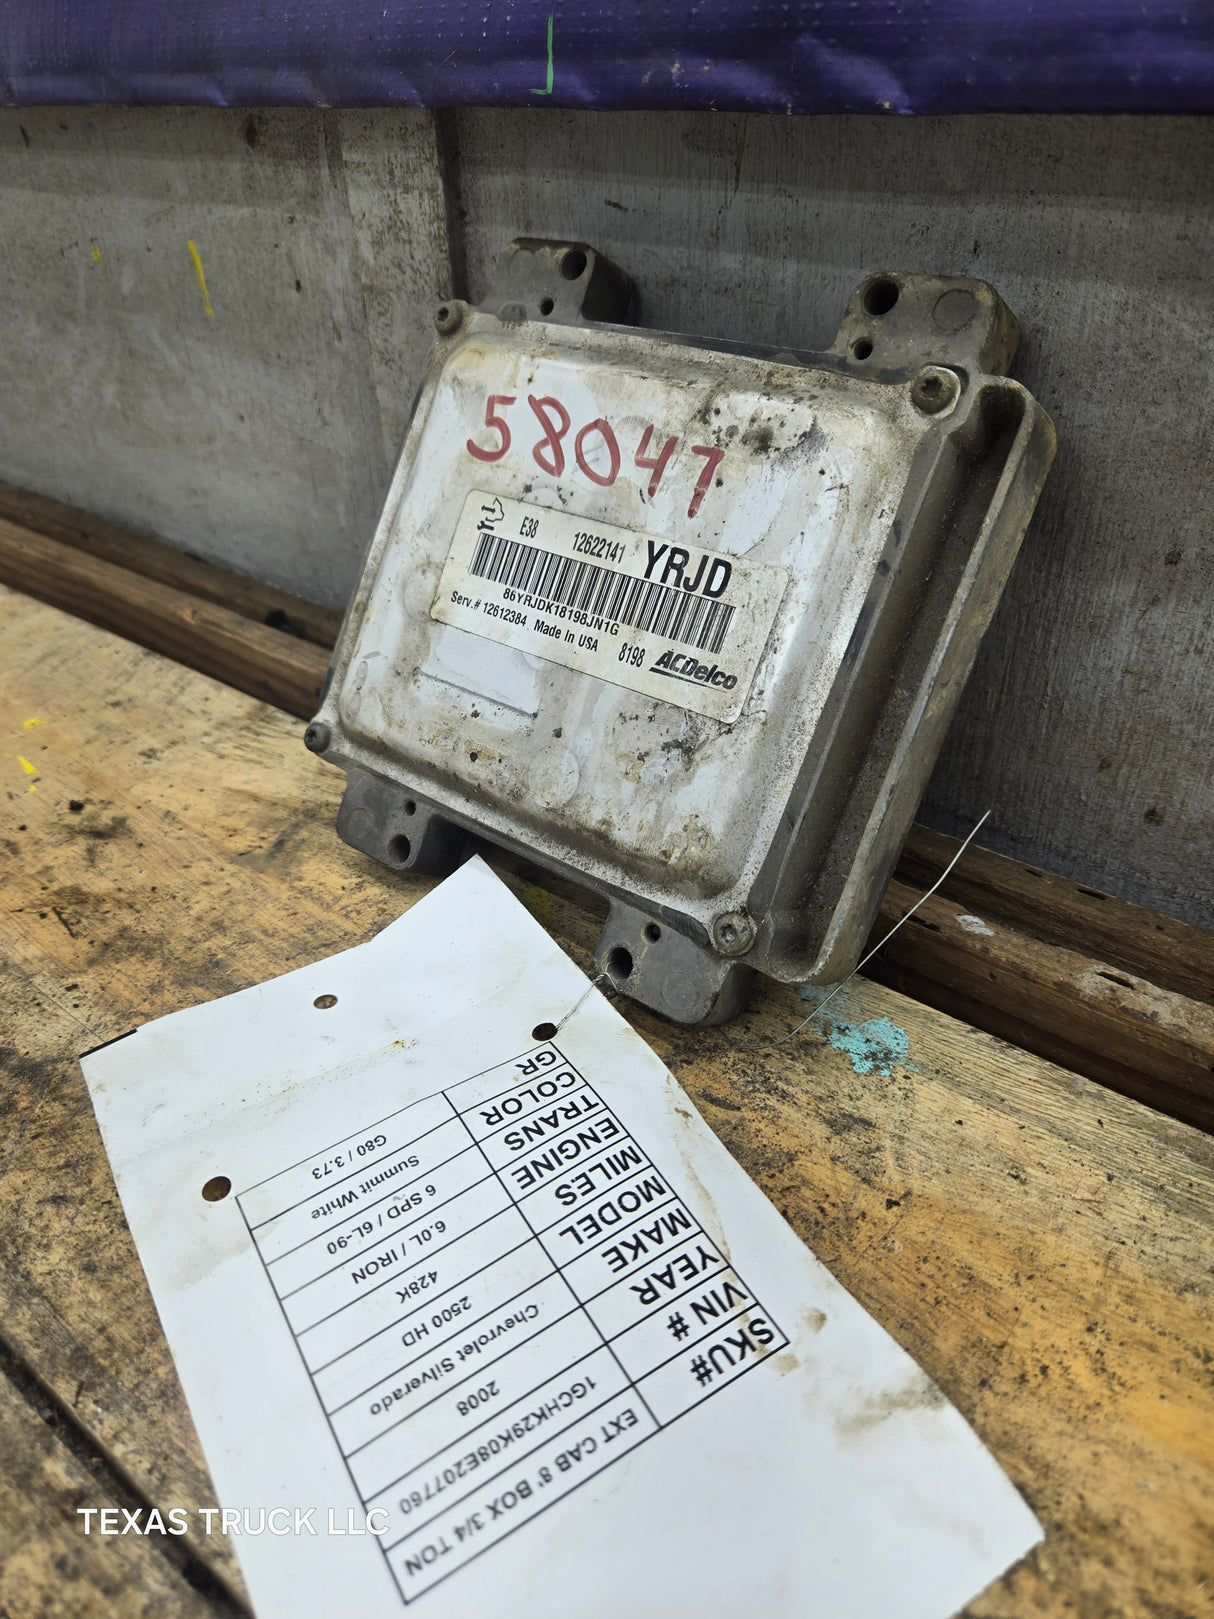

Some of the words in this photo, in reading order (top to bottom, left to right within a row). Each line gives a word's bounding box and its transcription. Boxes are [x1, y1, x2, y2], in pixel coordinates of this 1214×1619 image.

[466, 394, 725, 519] 58047
[519, 516, 540, 538] E38
[571, 532, 627, 565] 12622141
[643, 540, 733, 599] YRJD
[502, 588, 621, 637] 86YRJDK18198JN1G
[482, 602, 528, 628] 12612384
[533, 620, 562, 641] Made
[578, 633, 599, 653] USA
[618, 645, 646, 668] 8198
[655, 650, 739, 691] ACDelco
[514, 1050, 557, 1076] GR
[479, 1071, 576, 1127] COLOR
[503, 1094, 600, 1151] TRANS
[356, 1134, 387, 1157] G80
[510, 1117, 620, 1190] ENGINE
[311, 1155, 345, 1180] 3.73
[359, 1154, 420, 1195] Summit
[554, 1145, 643, 1206] MILES
[311, 1189, 360, 1220] White
[386, 1191, 423, 1219] SPD
[425, 1184, 437, 1197] 6
[558, 1175, 667, 1245] MODEL
[326, 1220, 374, 1255] 6L-90
[408, 1219, 447, 1247] 6.0L
[601, 1207, 693, 1273] MAKE
[351, 1248, 399, 1285] IRON
[396, 1270, 439, 1304] 428K
[629, 1245, 721, 1305] YEAR
[431, 1295, 473, 1323] 2500
[689, 1281, 749, 1326] VIN
[401, 1322, 430, 1348] HD
[457, 1303, 541, 1362] Chevrolet
[666, 1311, 691, 1342] #
[690, 1317, 776, 1387] SKU#
[369, 1357, 456, 1416] Silverado
[455, 1380, 501, 1417] 2008
[399, 1376, 598, 1515] 1GCHK29K08E207760
[600, 1408, 640, 1445] EXT
[554, 1436, 598, 1474] CAB
[485, 1478, 535, 1521] BOX
[453, 1512, 486, 1543] 3/4
[404, 1536, 454, 1576] TON
